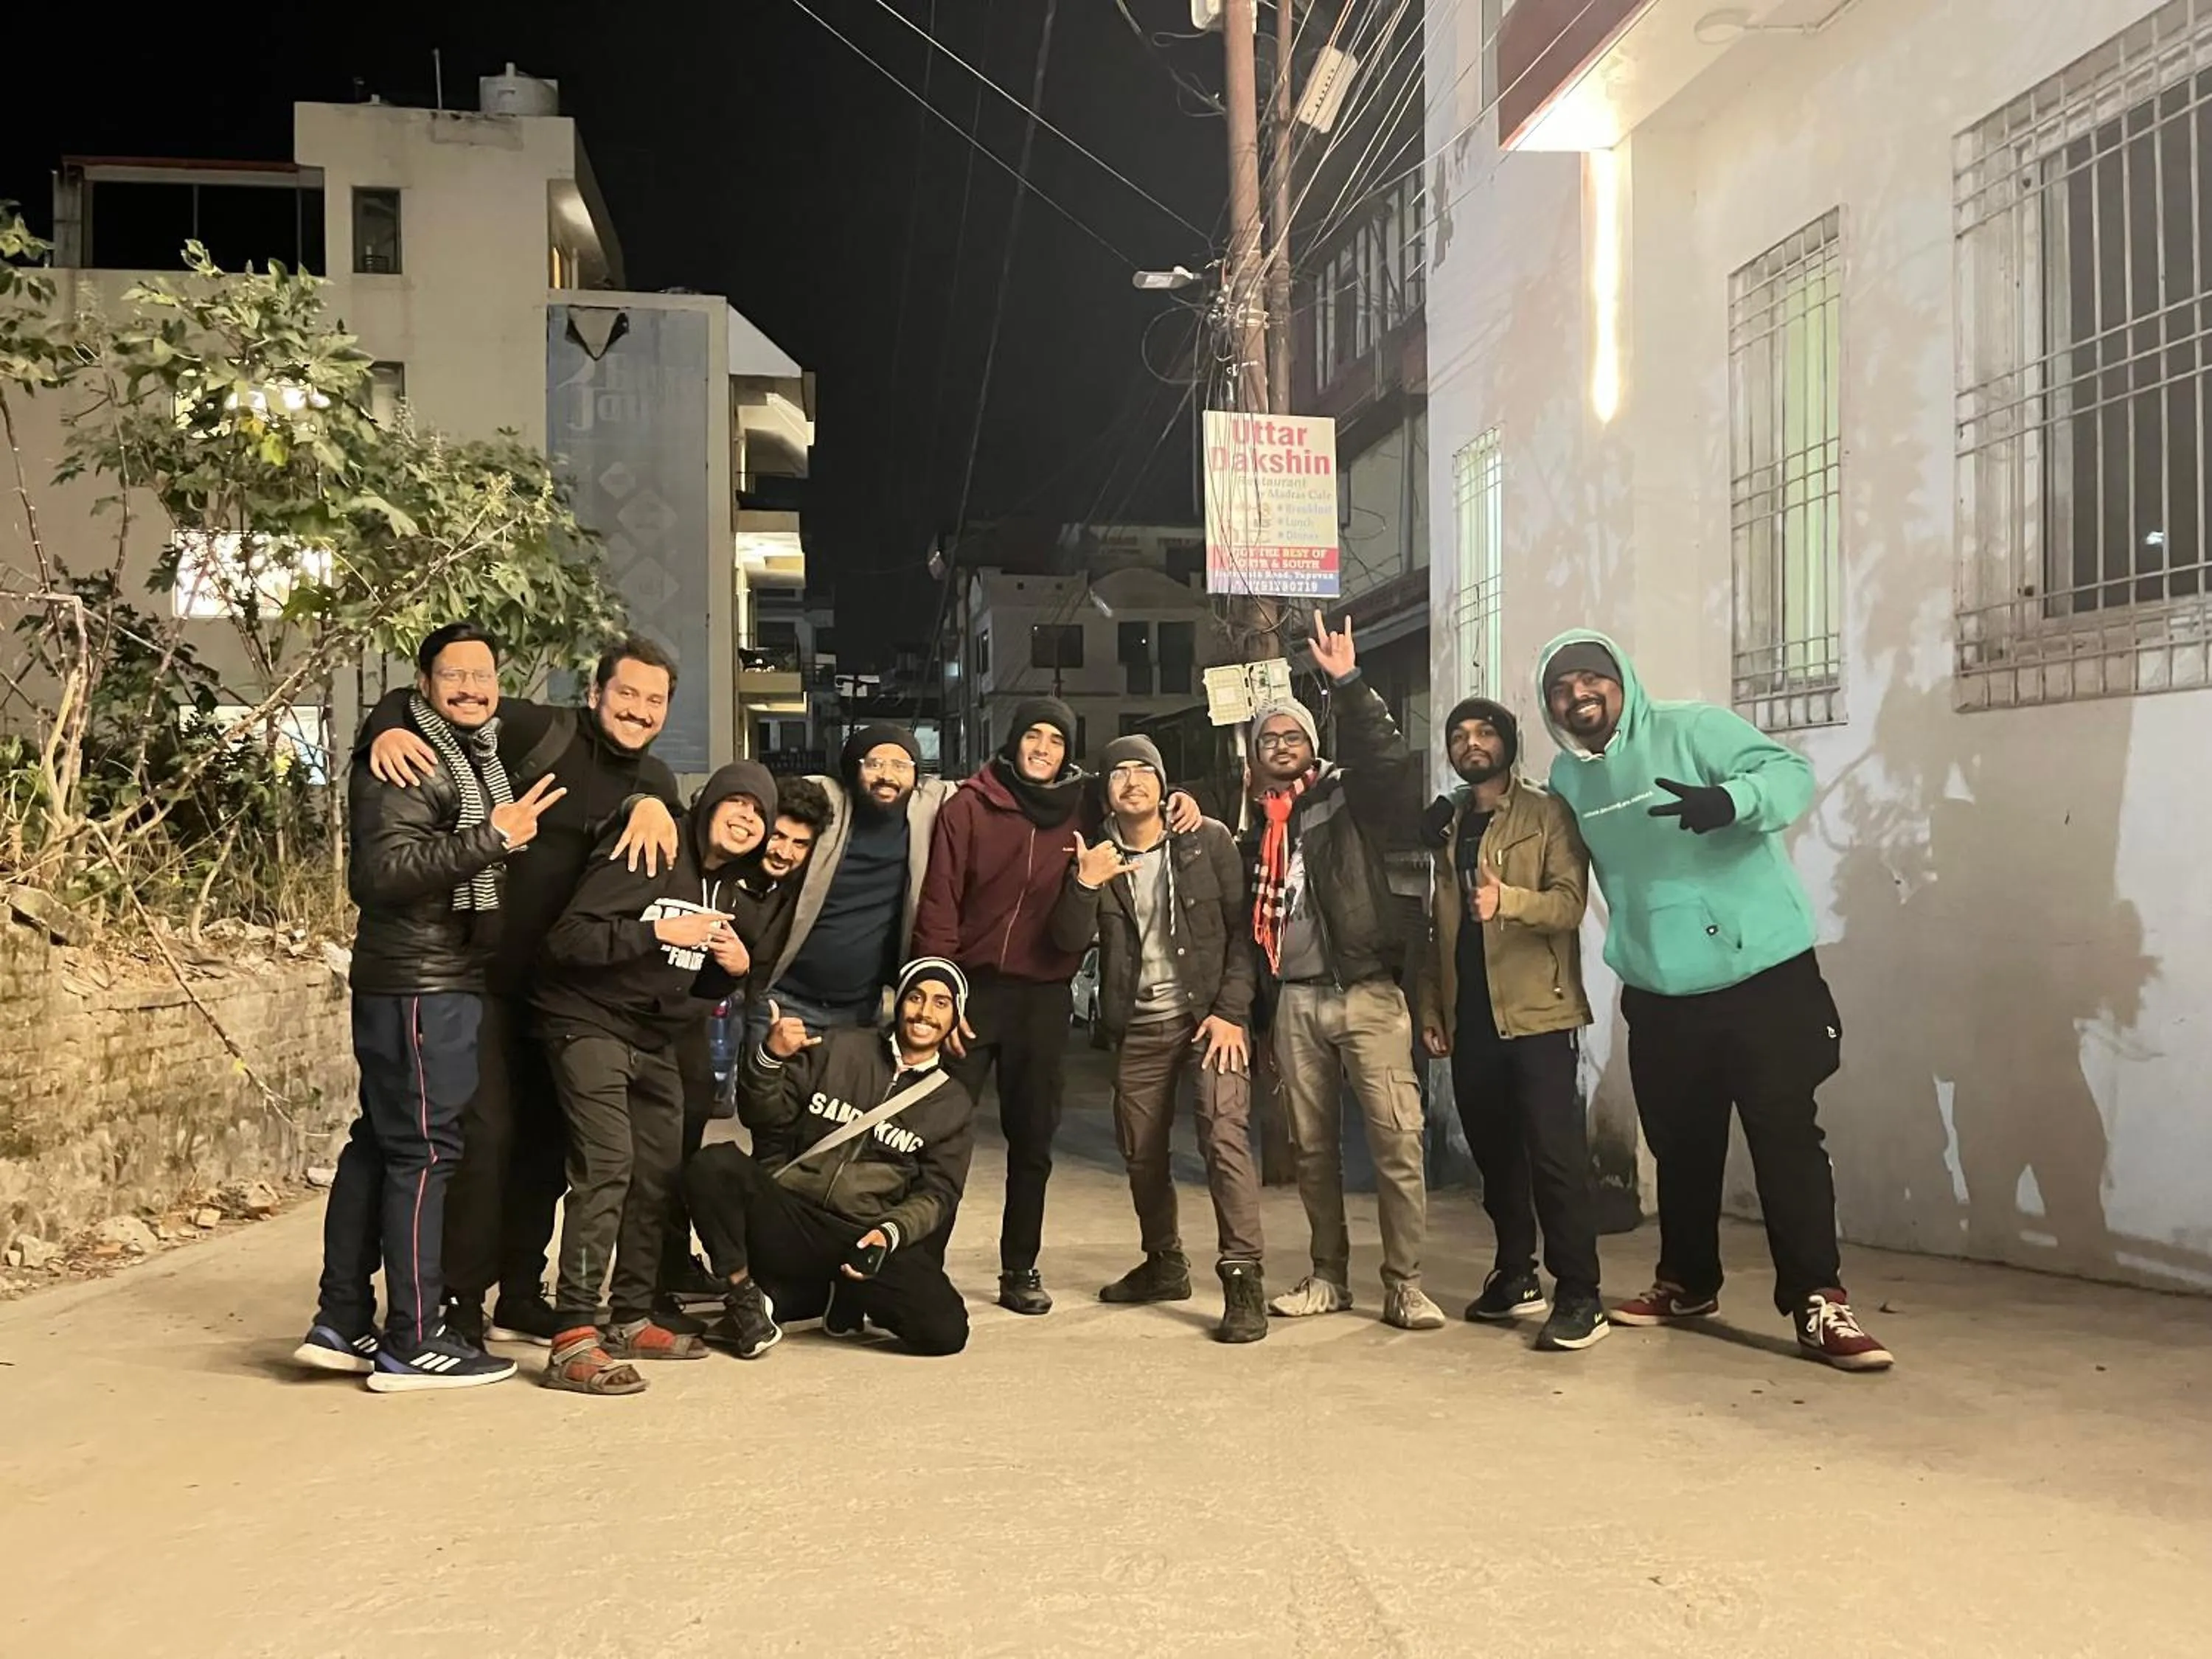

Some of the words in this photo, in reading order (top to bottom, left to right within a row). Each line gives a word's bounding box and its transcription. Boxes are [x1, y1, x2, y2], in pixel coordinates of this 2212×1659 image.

[1232, 419, 1308, 447] Uttar
[1211, 446, 1331, 476] Dakshin
[1311, 549, 1328, 558] OF
[1281, 559, 1321, 568] SOUTH
